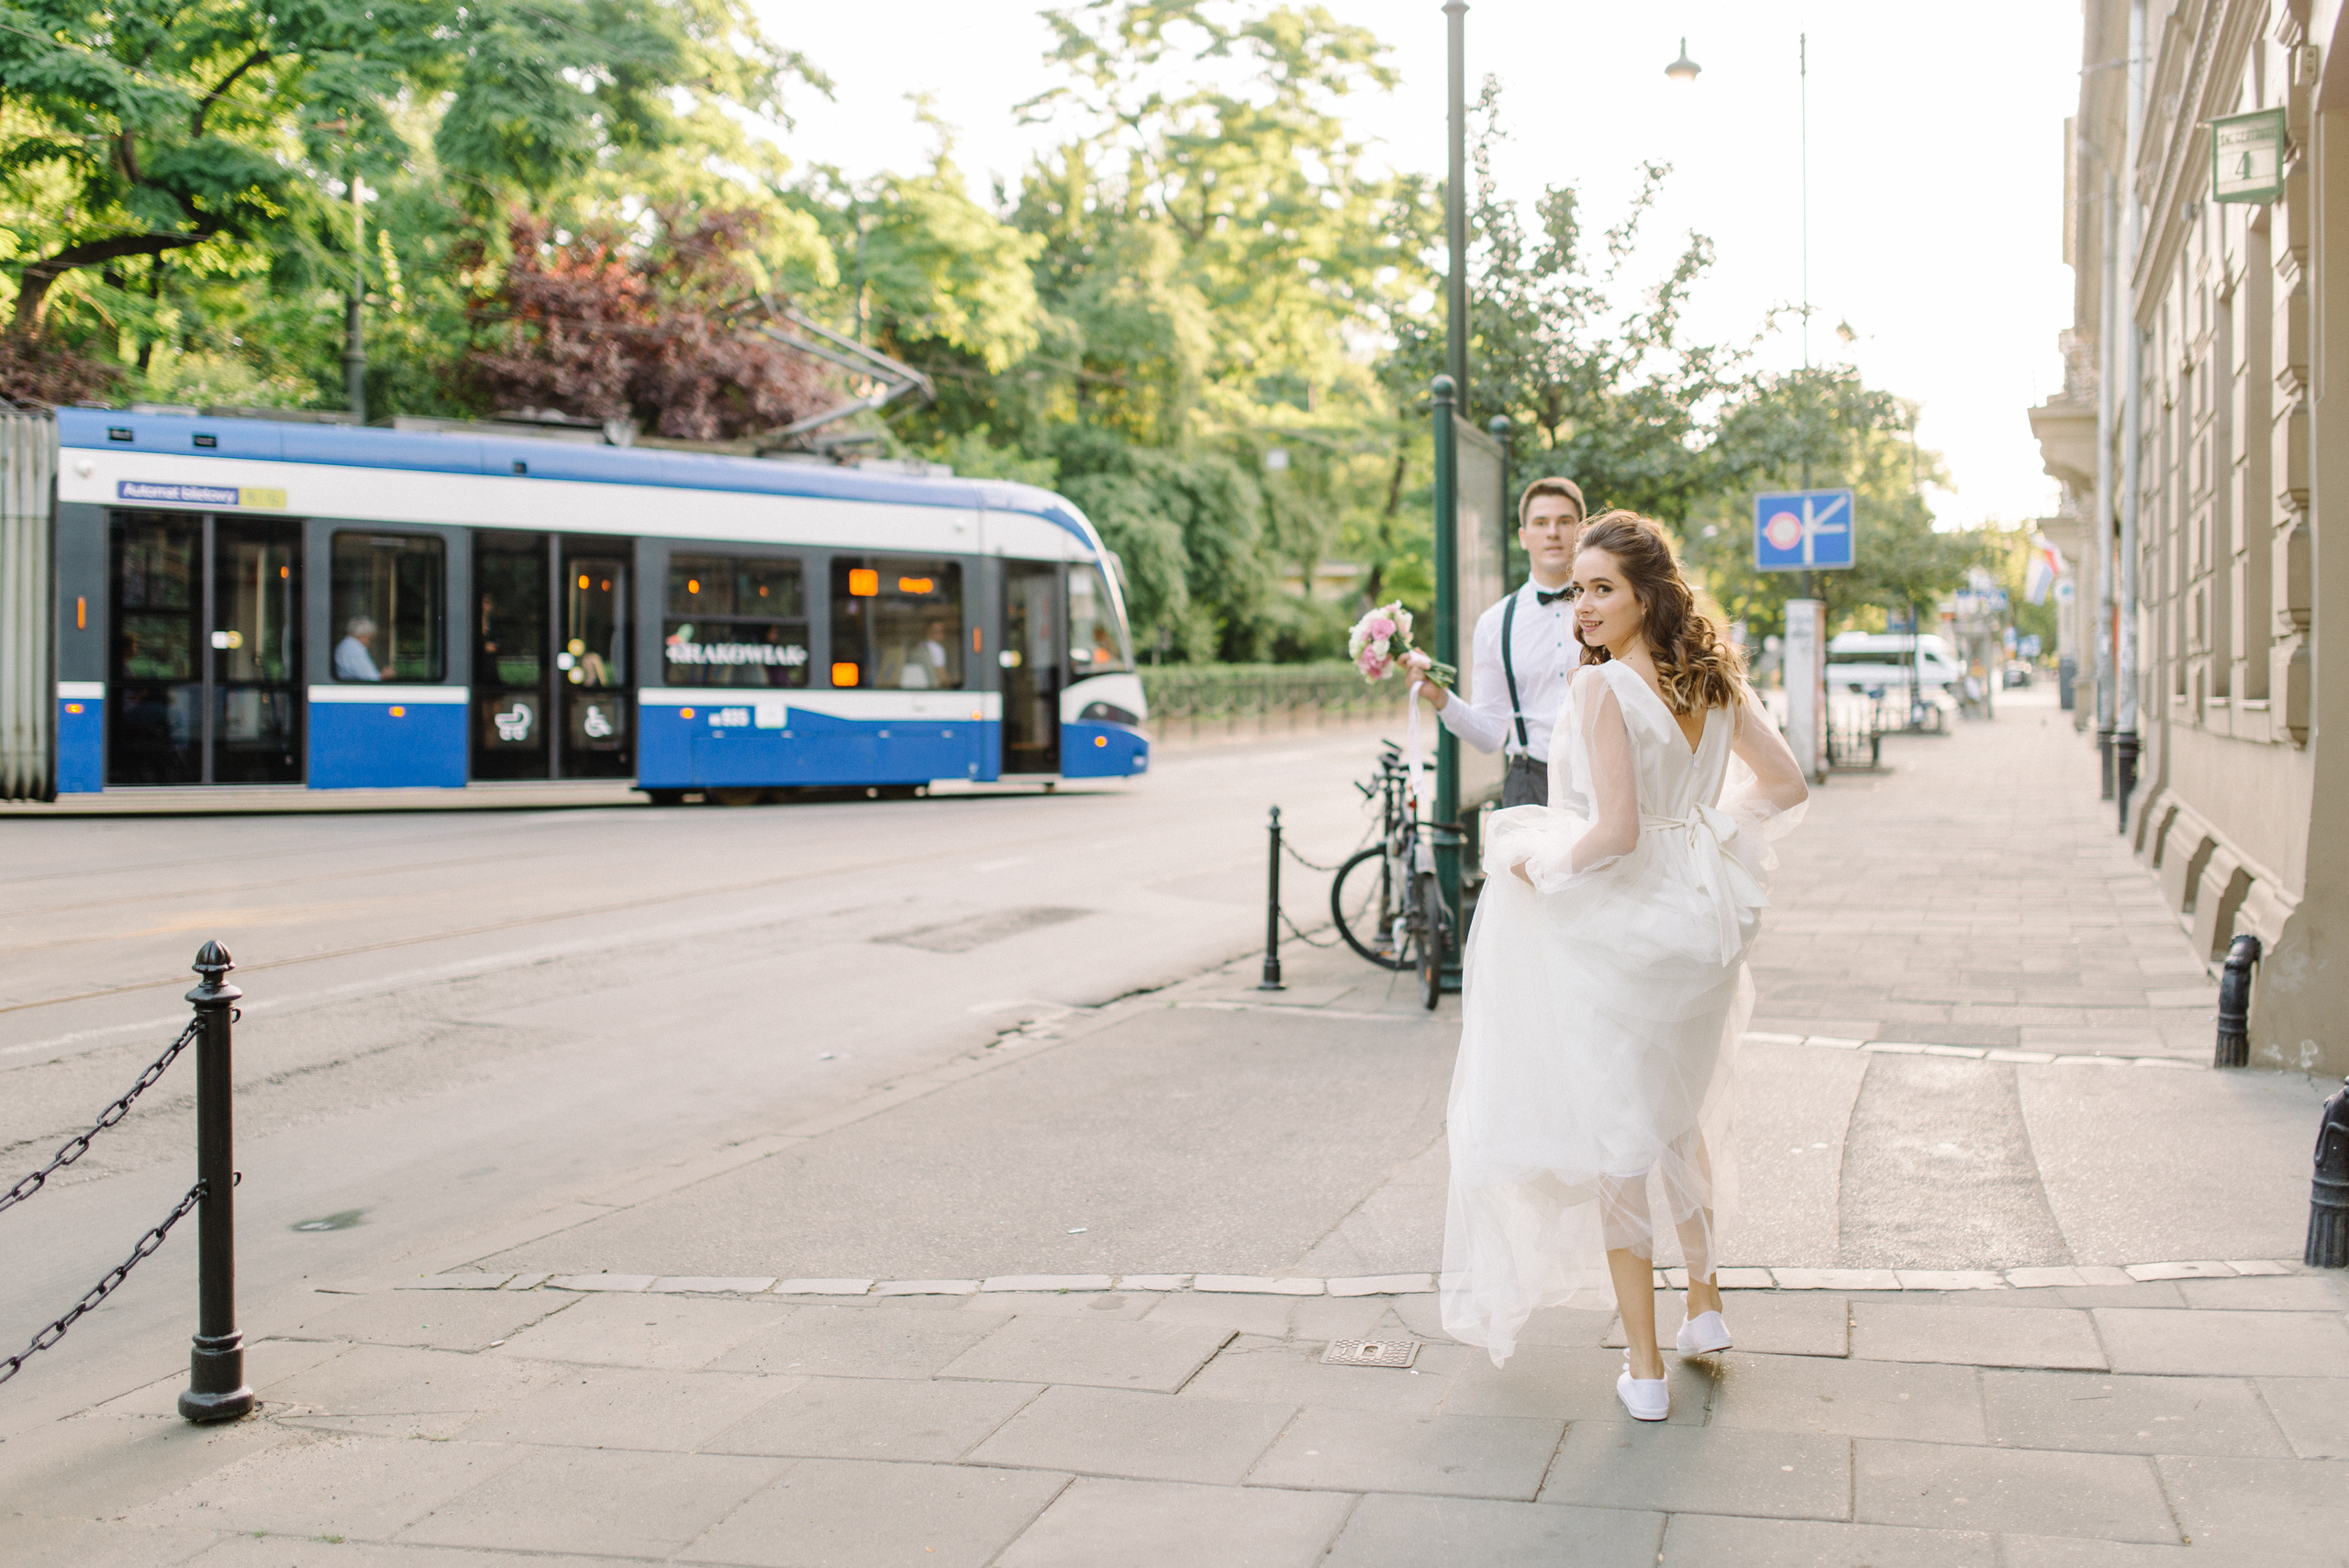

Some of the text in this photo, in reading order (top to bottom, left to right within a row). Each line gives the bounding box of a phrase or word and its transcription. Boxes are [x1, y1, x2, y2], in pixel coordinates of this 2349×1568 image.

[2235, 150, 2253, 181] 4
[123, 482, 181, 501] Automat
[668, 641, 806, 666] KRAKOWIAK
